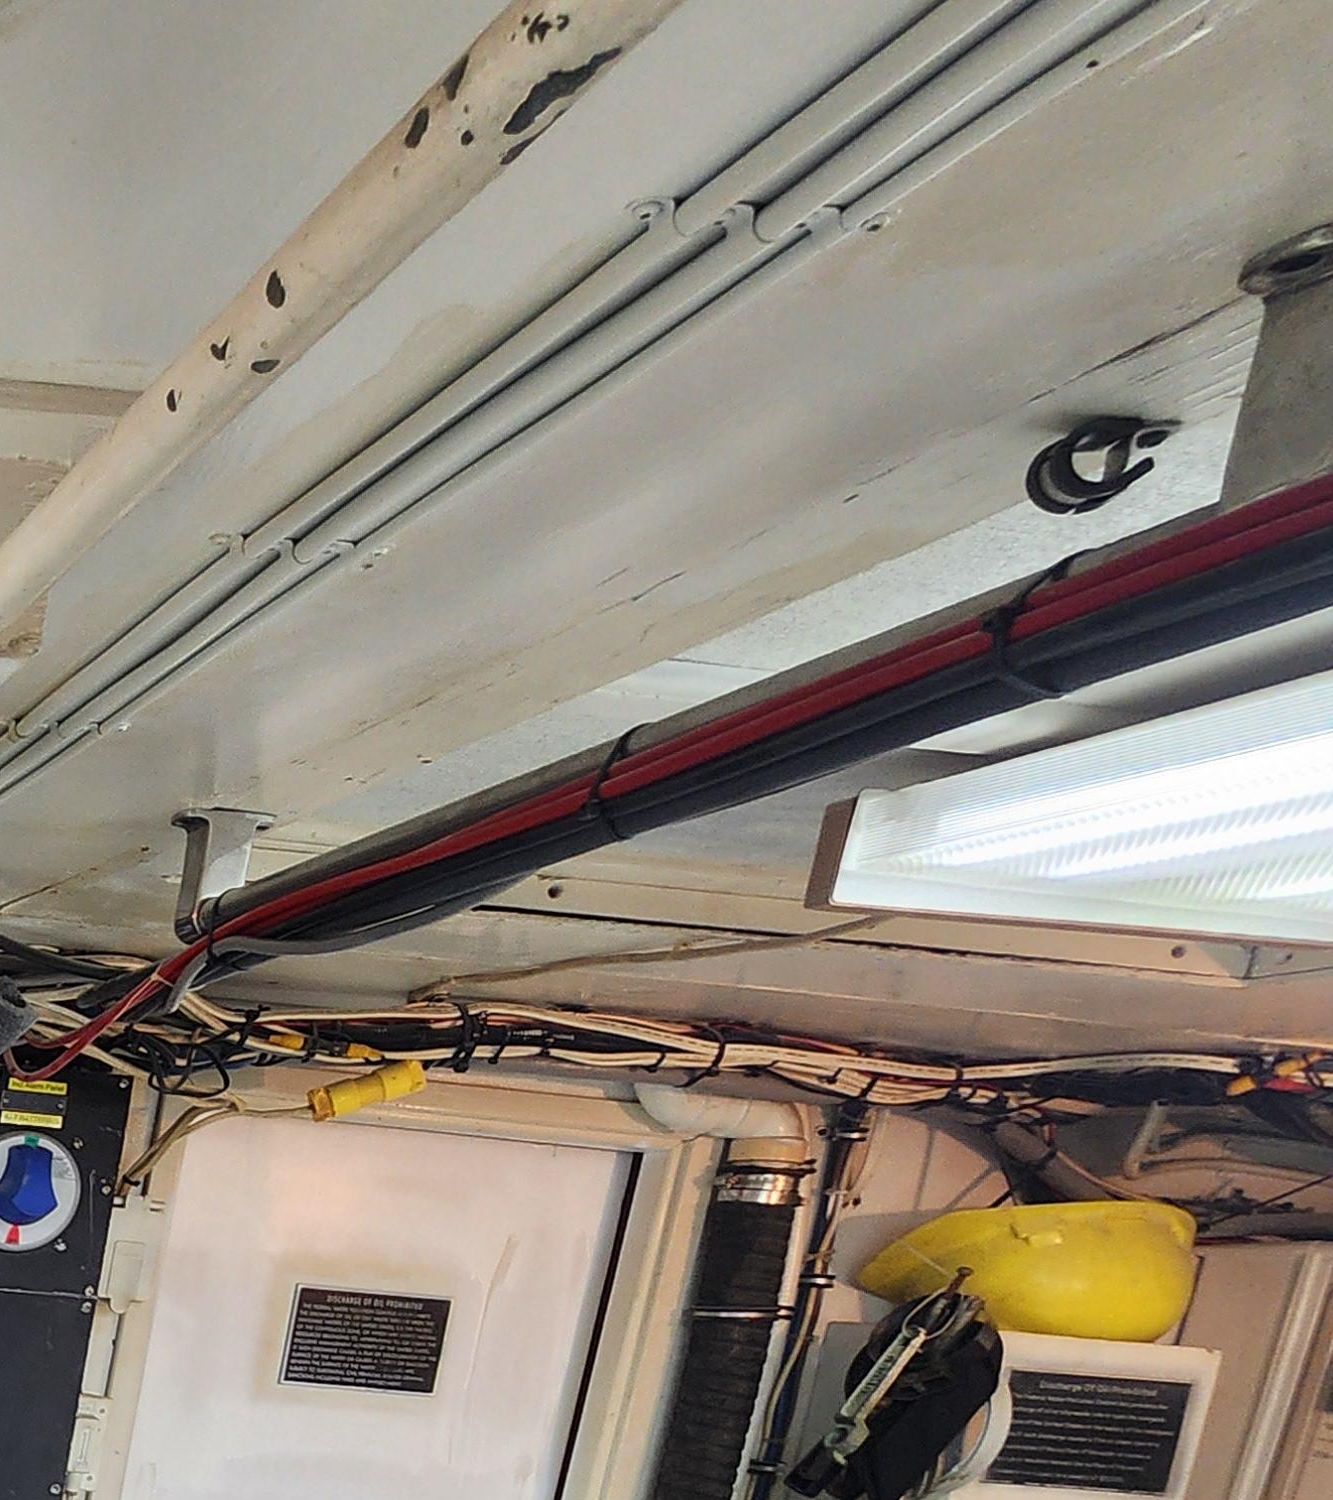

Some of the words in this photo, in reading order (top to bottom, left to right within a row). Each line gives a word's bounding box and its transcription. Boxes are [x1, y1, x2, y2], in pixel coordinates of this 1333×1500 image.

[46, 1084, 65, 1092] Panel
[326, 1294, 362, 1305] DISCHARGE
[385, 1299, 424, 1310] PROHIBITED
